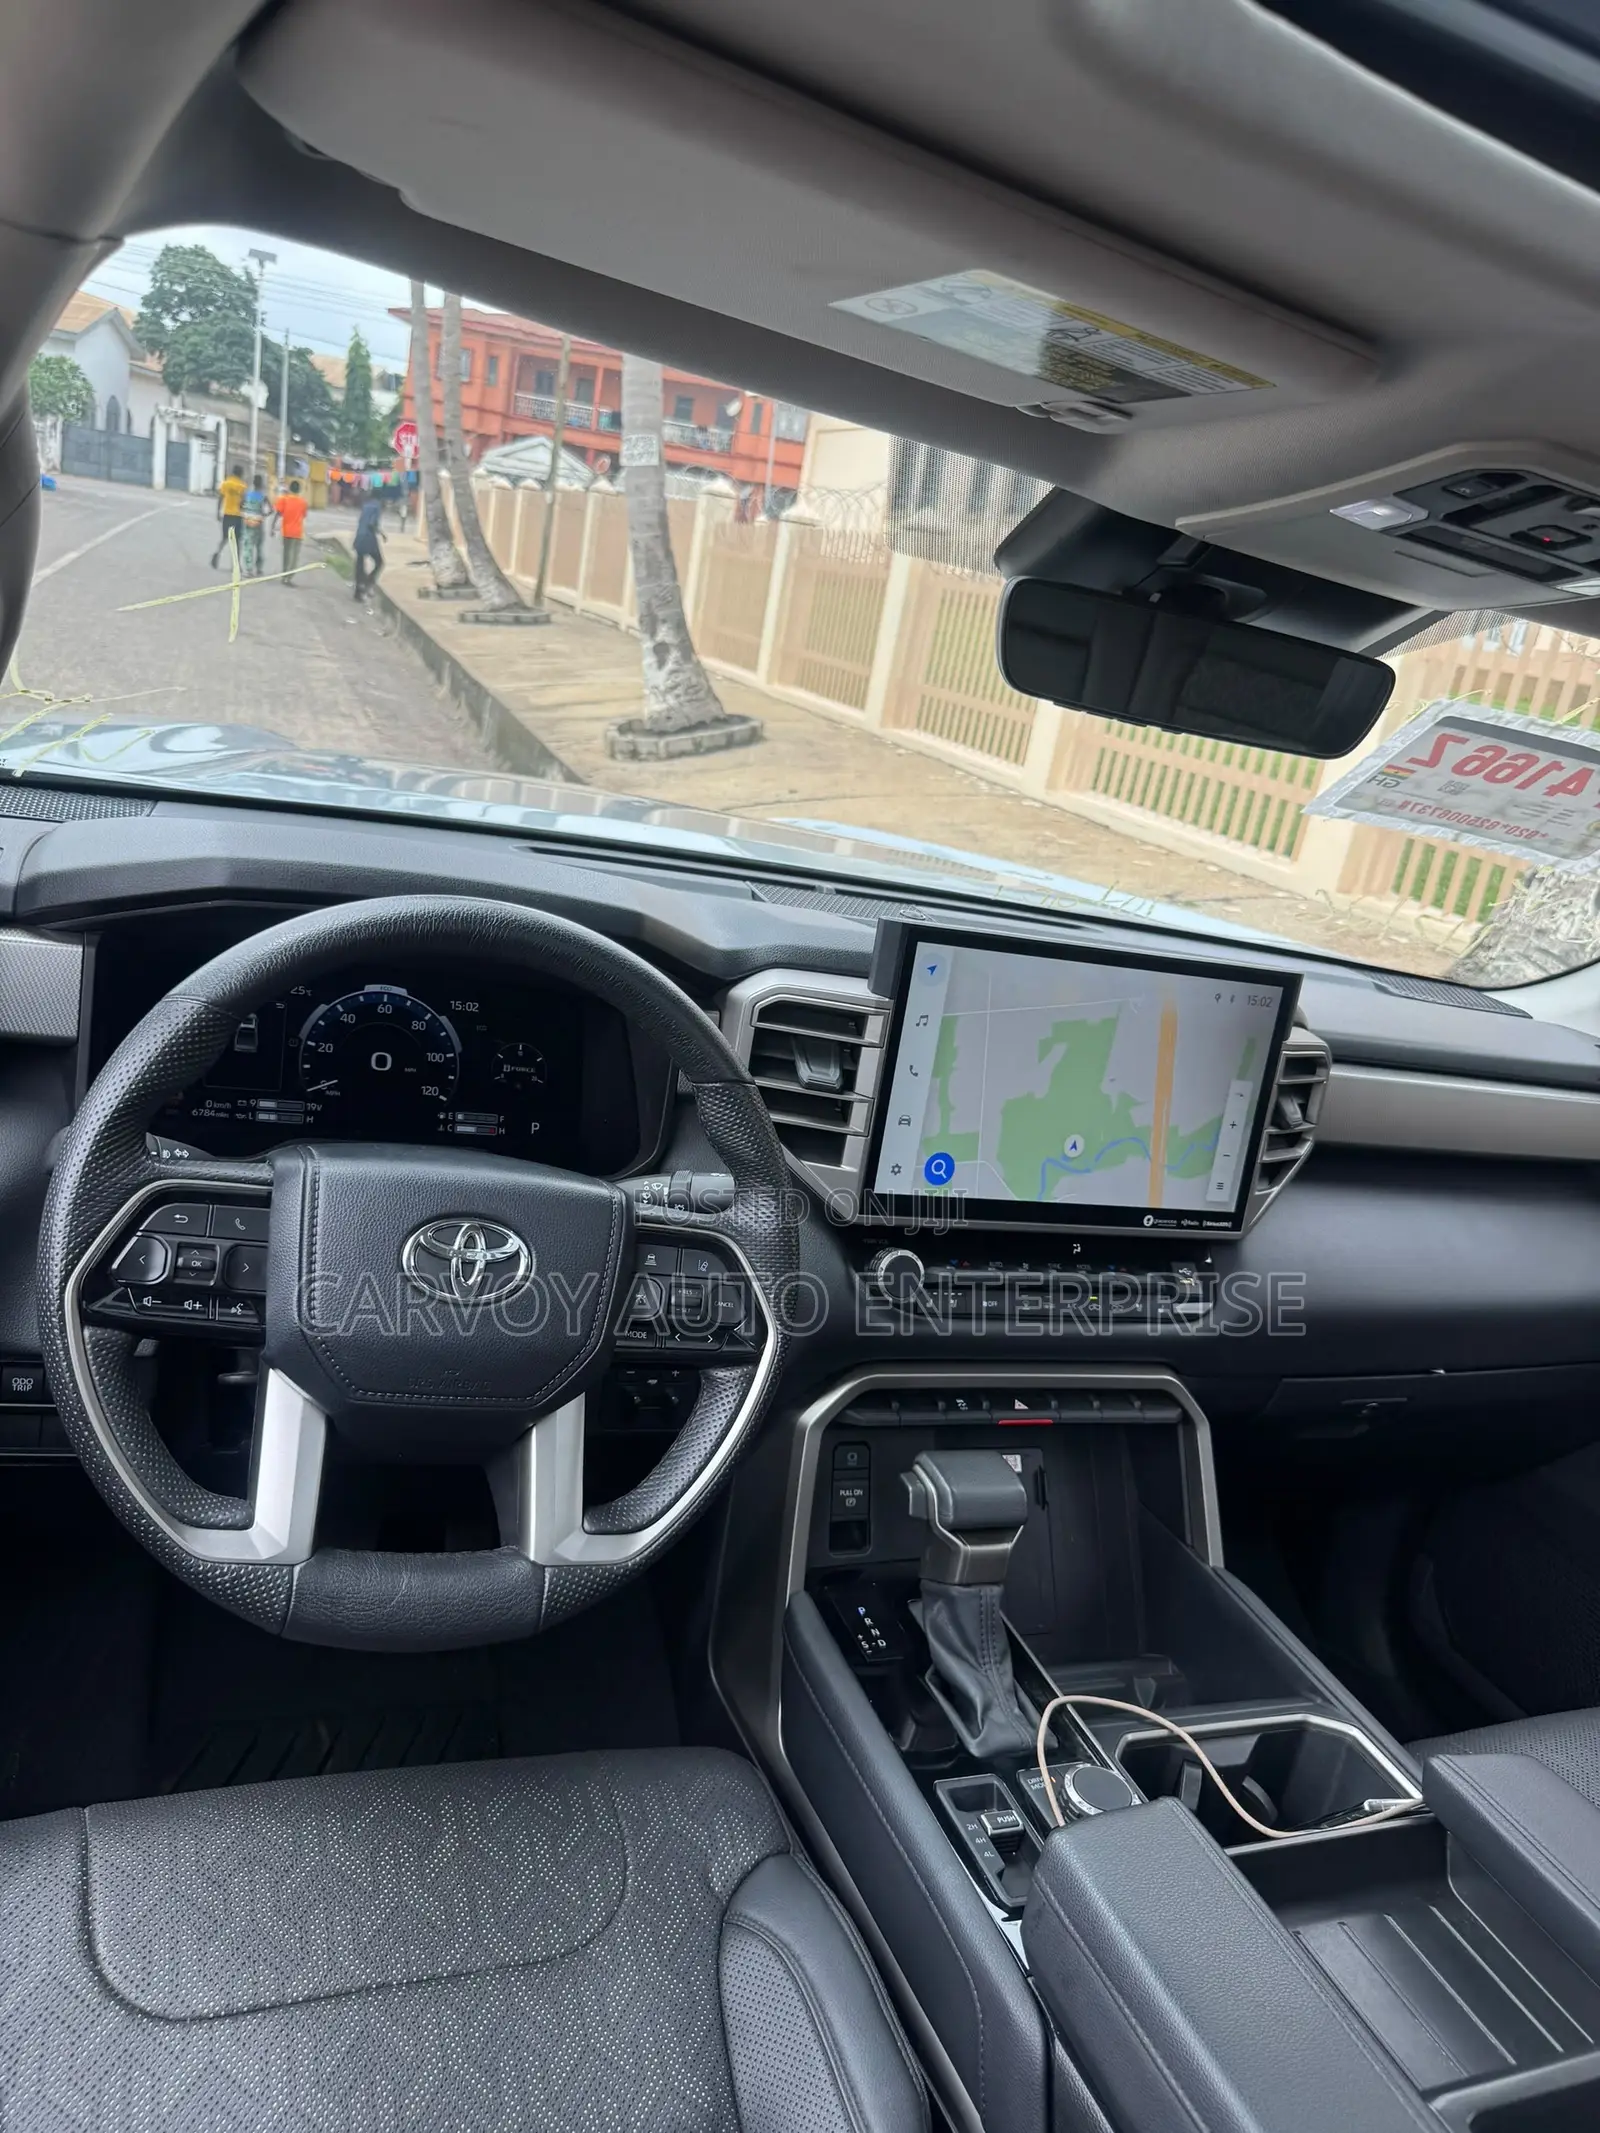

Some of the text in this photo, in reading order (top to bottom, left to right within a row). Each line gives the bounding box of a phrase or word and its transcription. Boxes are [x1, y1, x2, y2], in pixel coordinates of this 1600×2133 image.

[377, 1004, 393, 1014] 60
[450, 1001, 479, 1012] 15:02
[340, 1013, 356, 1024] 40
[411, 1020, 426, 1031] 80
[317, 1042, 334, 1053] 20
[370, 1051, 393, 1071] 0
[426, 1052, 445, 1063] 100
[421, 1085, 439, 1096] 120
[531, 1122, 540, 1134] P
[714, 1300, 735, 1308] CANCEL
[624, 1330, 648, 1340] MODE
[12, 1377, 34, 1385] ODO
[12, 1384, 33, 1392] TRIP
[839, 1489, 853, 1497] PULL
[858, 1606, 866, 1616] P
[864, 1617, 874, 1627] R
[871, 1628, 880, 1637] N
[861, 1640, 869, 1649] S
[877, 1639, 887, 1647] D
[996, 1815, 1016, 1824] PUSH
[966, 1823, 978, 1831] 2H
[975, 1837, 987, 1845] 4H
